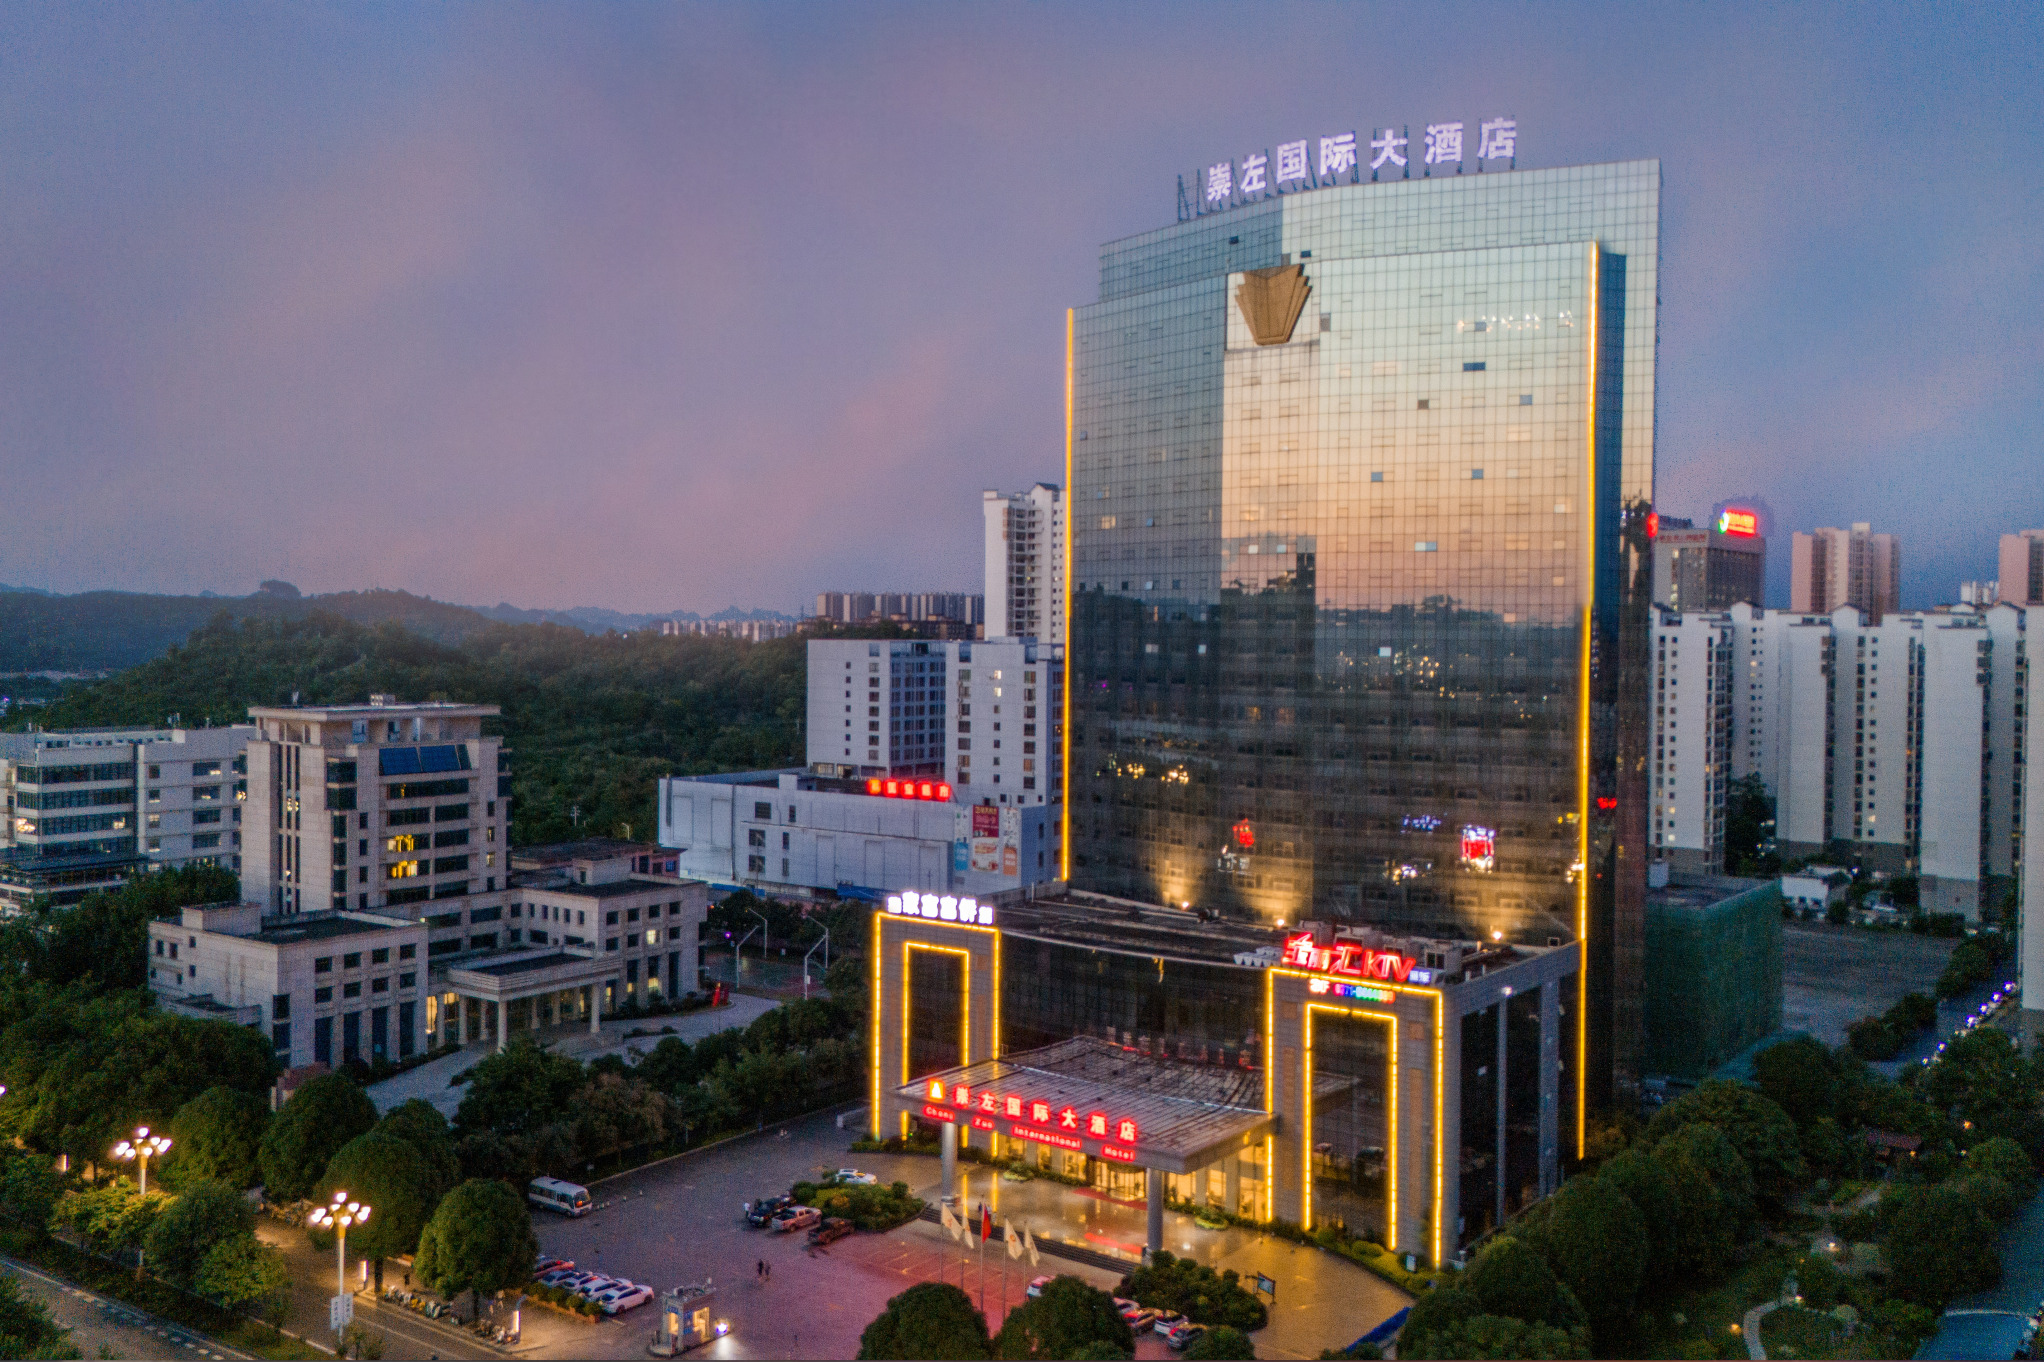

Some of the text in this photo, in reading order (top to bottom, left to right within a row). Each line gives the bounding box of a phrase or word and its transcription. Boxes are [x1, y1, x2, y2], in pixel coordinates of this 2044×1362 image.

[1207, 117, 1517, 201] 崇左国际大酒店
[954, 1085, 1137, 1143] 崇左国际大酒店
[973, 1117, 993, 1130] Zuo
[1013, 1126, 1081, 1148] International
[1103, 1145, 1134, 1160] Hotel
